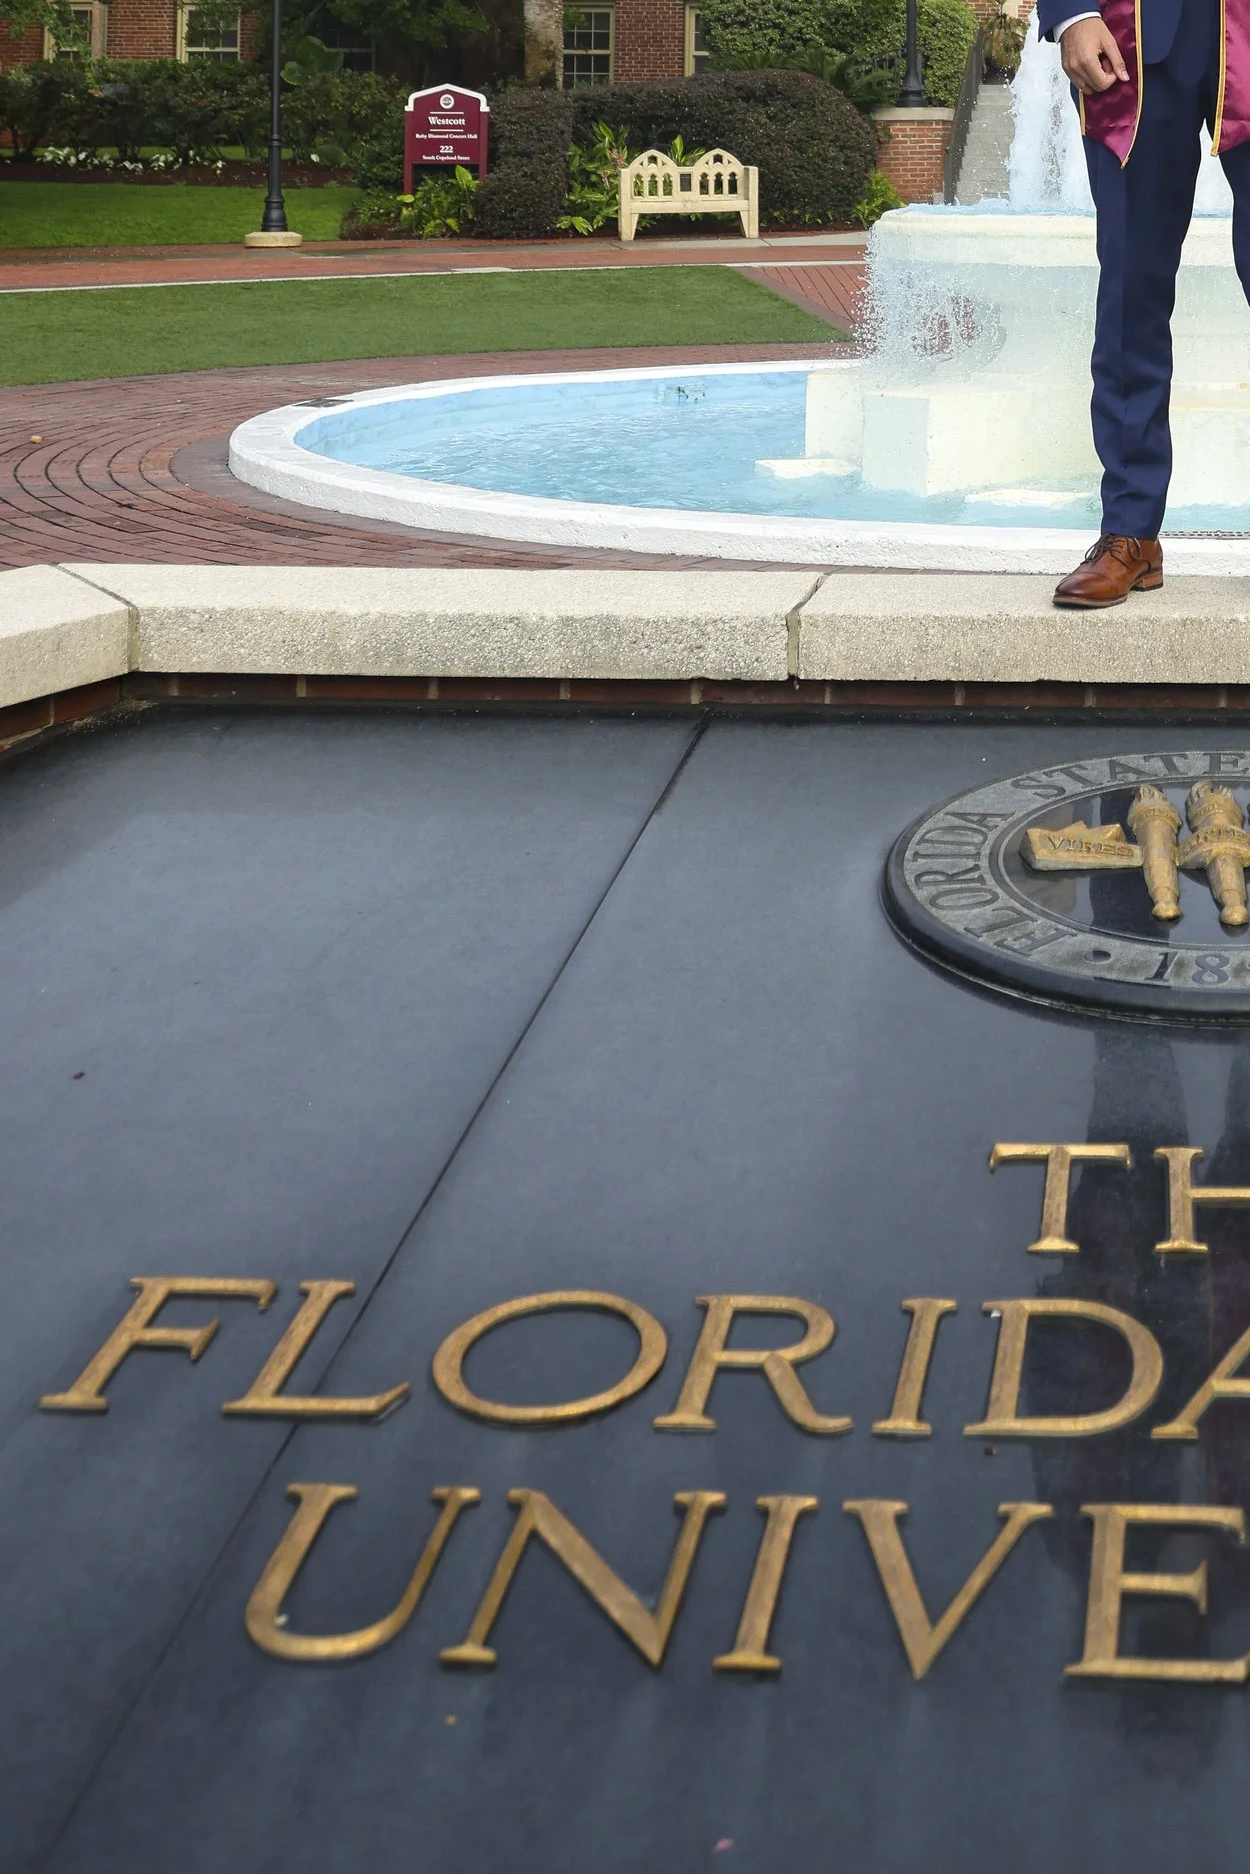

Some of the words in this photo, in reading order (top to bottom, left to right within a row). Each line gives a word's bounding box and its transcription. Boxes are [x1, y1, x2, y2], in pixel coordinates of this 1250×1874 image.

[428, 116, 466, 126] Westcott
[439, 145, 454, 153] 222
[913, 810, 1078, 957] FLORIDA
[1010, 751, 1250, 799] STATE
[1047, 836, 1134, 857] VIRES
